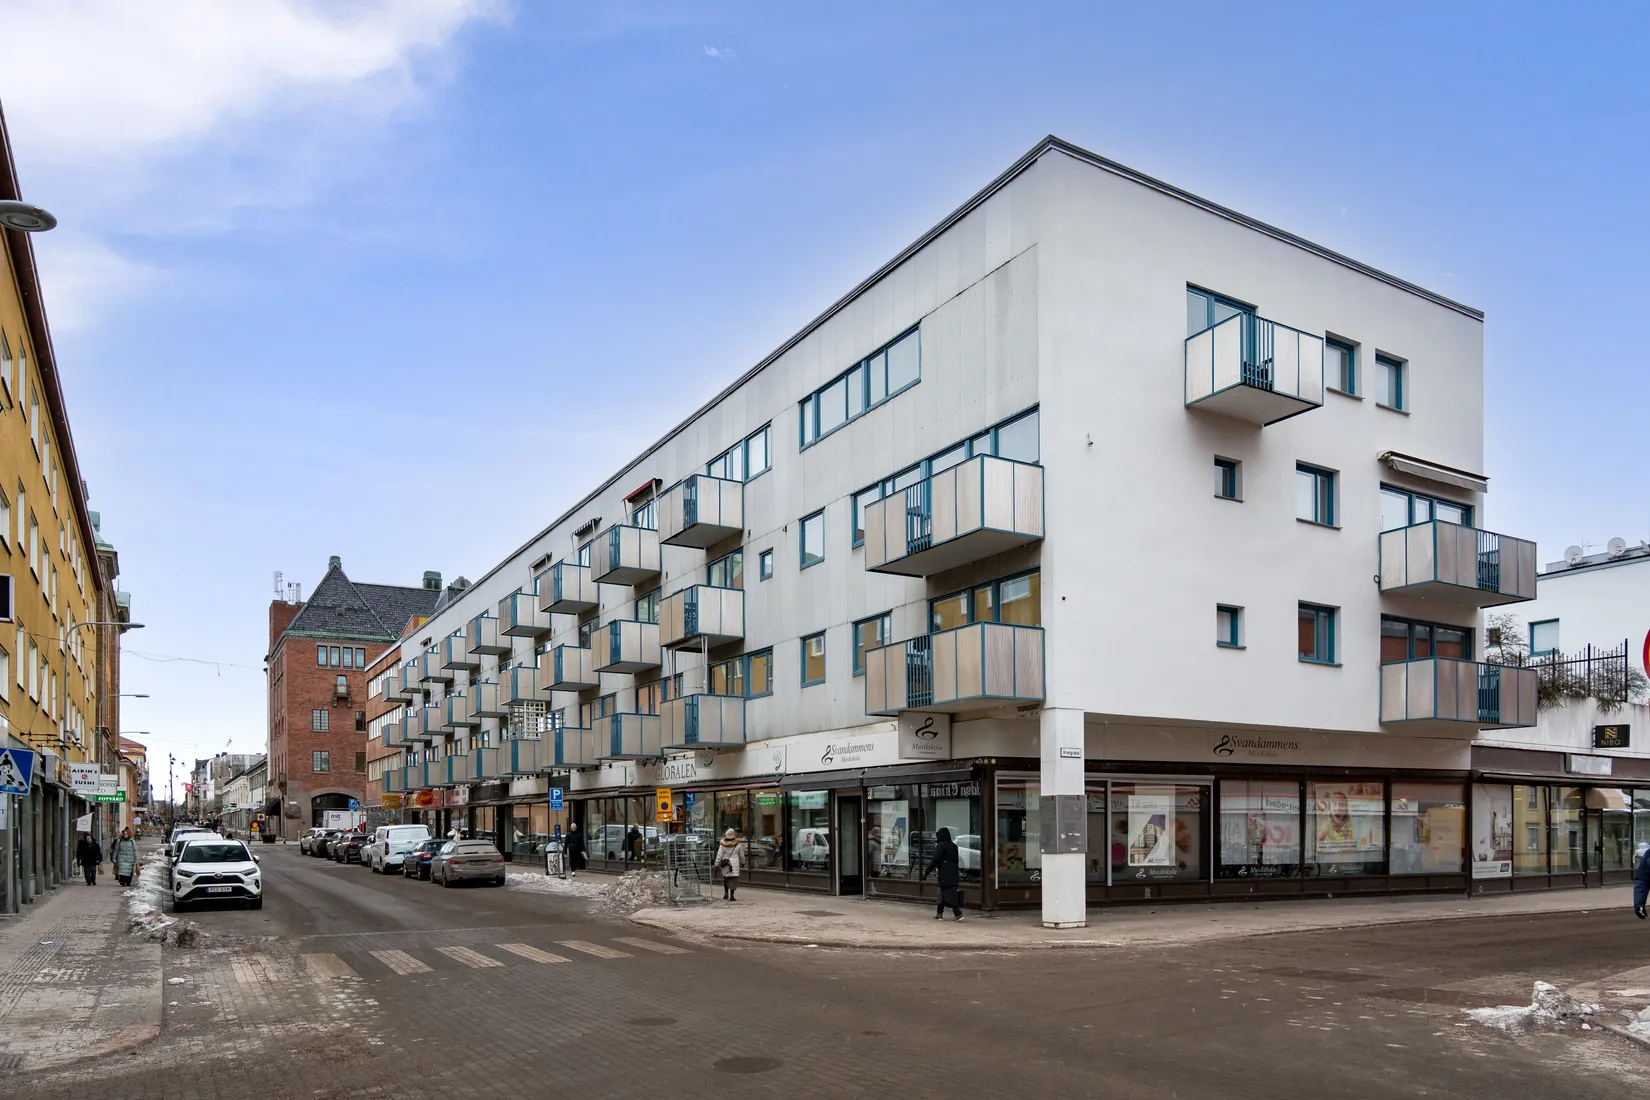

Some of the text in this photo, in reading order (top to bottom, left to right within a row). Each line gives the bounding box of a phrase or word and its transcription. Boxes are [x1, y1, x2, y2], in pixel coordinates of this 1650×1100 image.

[831, 742, 875, 756] Svandammens
[911, 742, 943, 751] Musikskola
[1231, 735, 1299, 750] Svandammens
[655, 763, 697, 781] GLOBALEN
[553, 789, 561, 800] P
